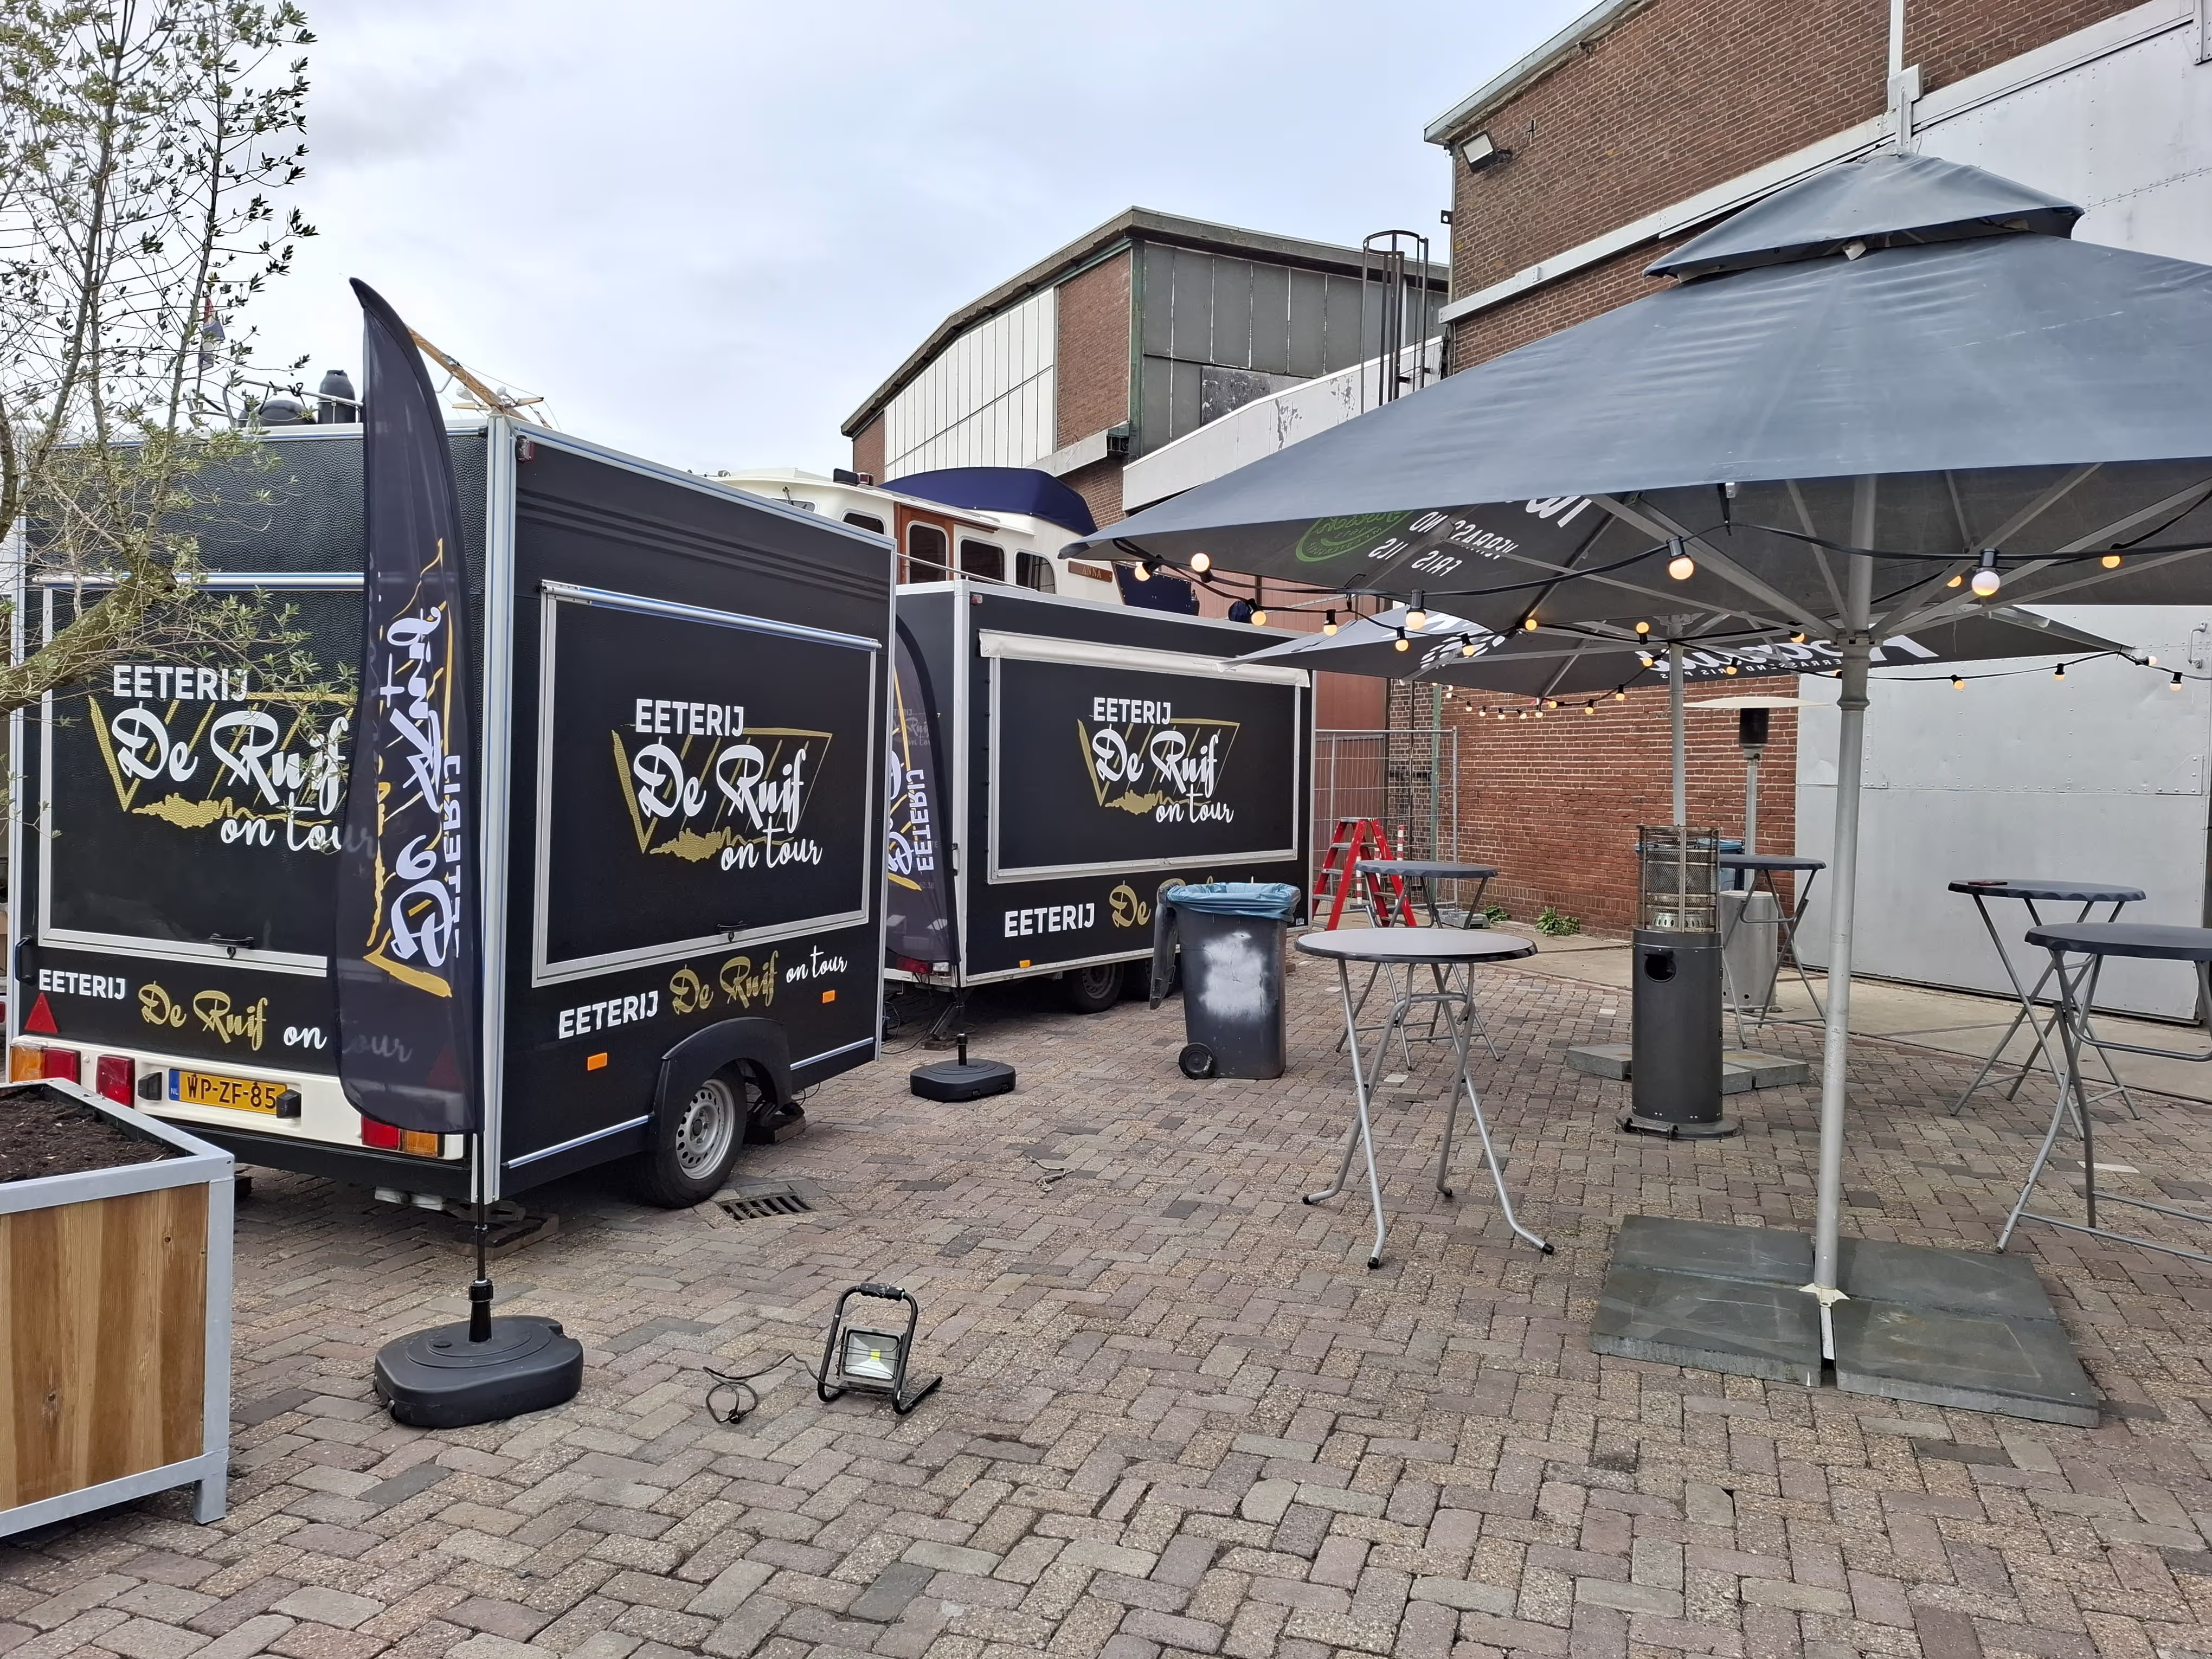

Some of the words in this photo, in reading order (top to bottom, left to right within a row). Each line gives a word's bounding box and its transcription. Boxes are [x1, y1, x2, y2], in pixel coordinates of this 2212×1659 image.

[1081, 566, 1102, 578] ANNA
[113, 665, 248, 700] EETERIJ
[635, 699, 744, 736] EETERIJ
[1093, 697, 1171, 725] EETERIJ
[111, 701, 198, 782] De
[210, 711, 350, 816] Ruif
[1092, 724, 1144, 782] De
[1150, 730, 1219, 798] Ruif
[633, 737, 706, 818] De
[716, 744, 807, 834] Ruif
[1156, 801, 1185, 824] on
[1186, 783, 1234, 824] tour
[221, 817, 275, 846] on
[721, 842, 759, 871] on
[762, 816, 823, 869] tour
[1004, 902, 1095, 938] EETERIJ
[1109, 879, 1152, 929] De
[39, 968, 126, 1000] EETERIJ
[138, 980, 187, 1028] De
[192, 989, 269, 1052] Ruif
[283, 1025, 327, 1050] on
[558, 989, 658, 1040] EETERIJ
[669, 963, 715, 1015] De
[719, 950, 779, 1009] Ruif
[786, 965, 809, 983] on
[809, 945, 848, 976] tour
[170, 1087, 179, 1096] NL
[187, 1073, 276, 1110] WP-ZF-85
